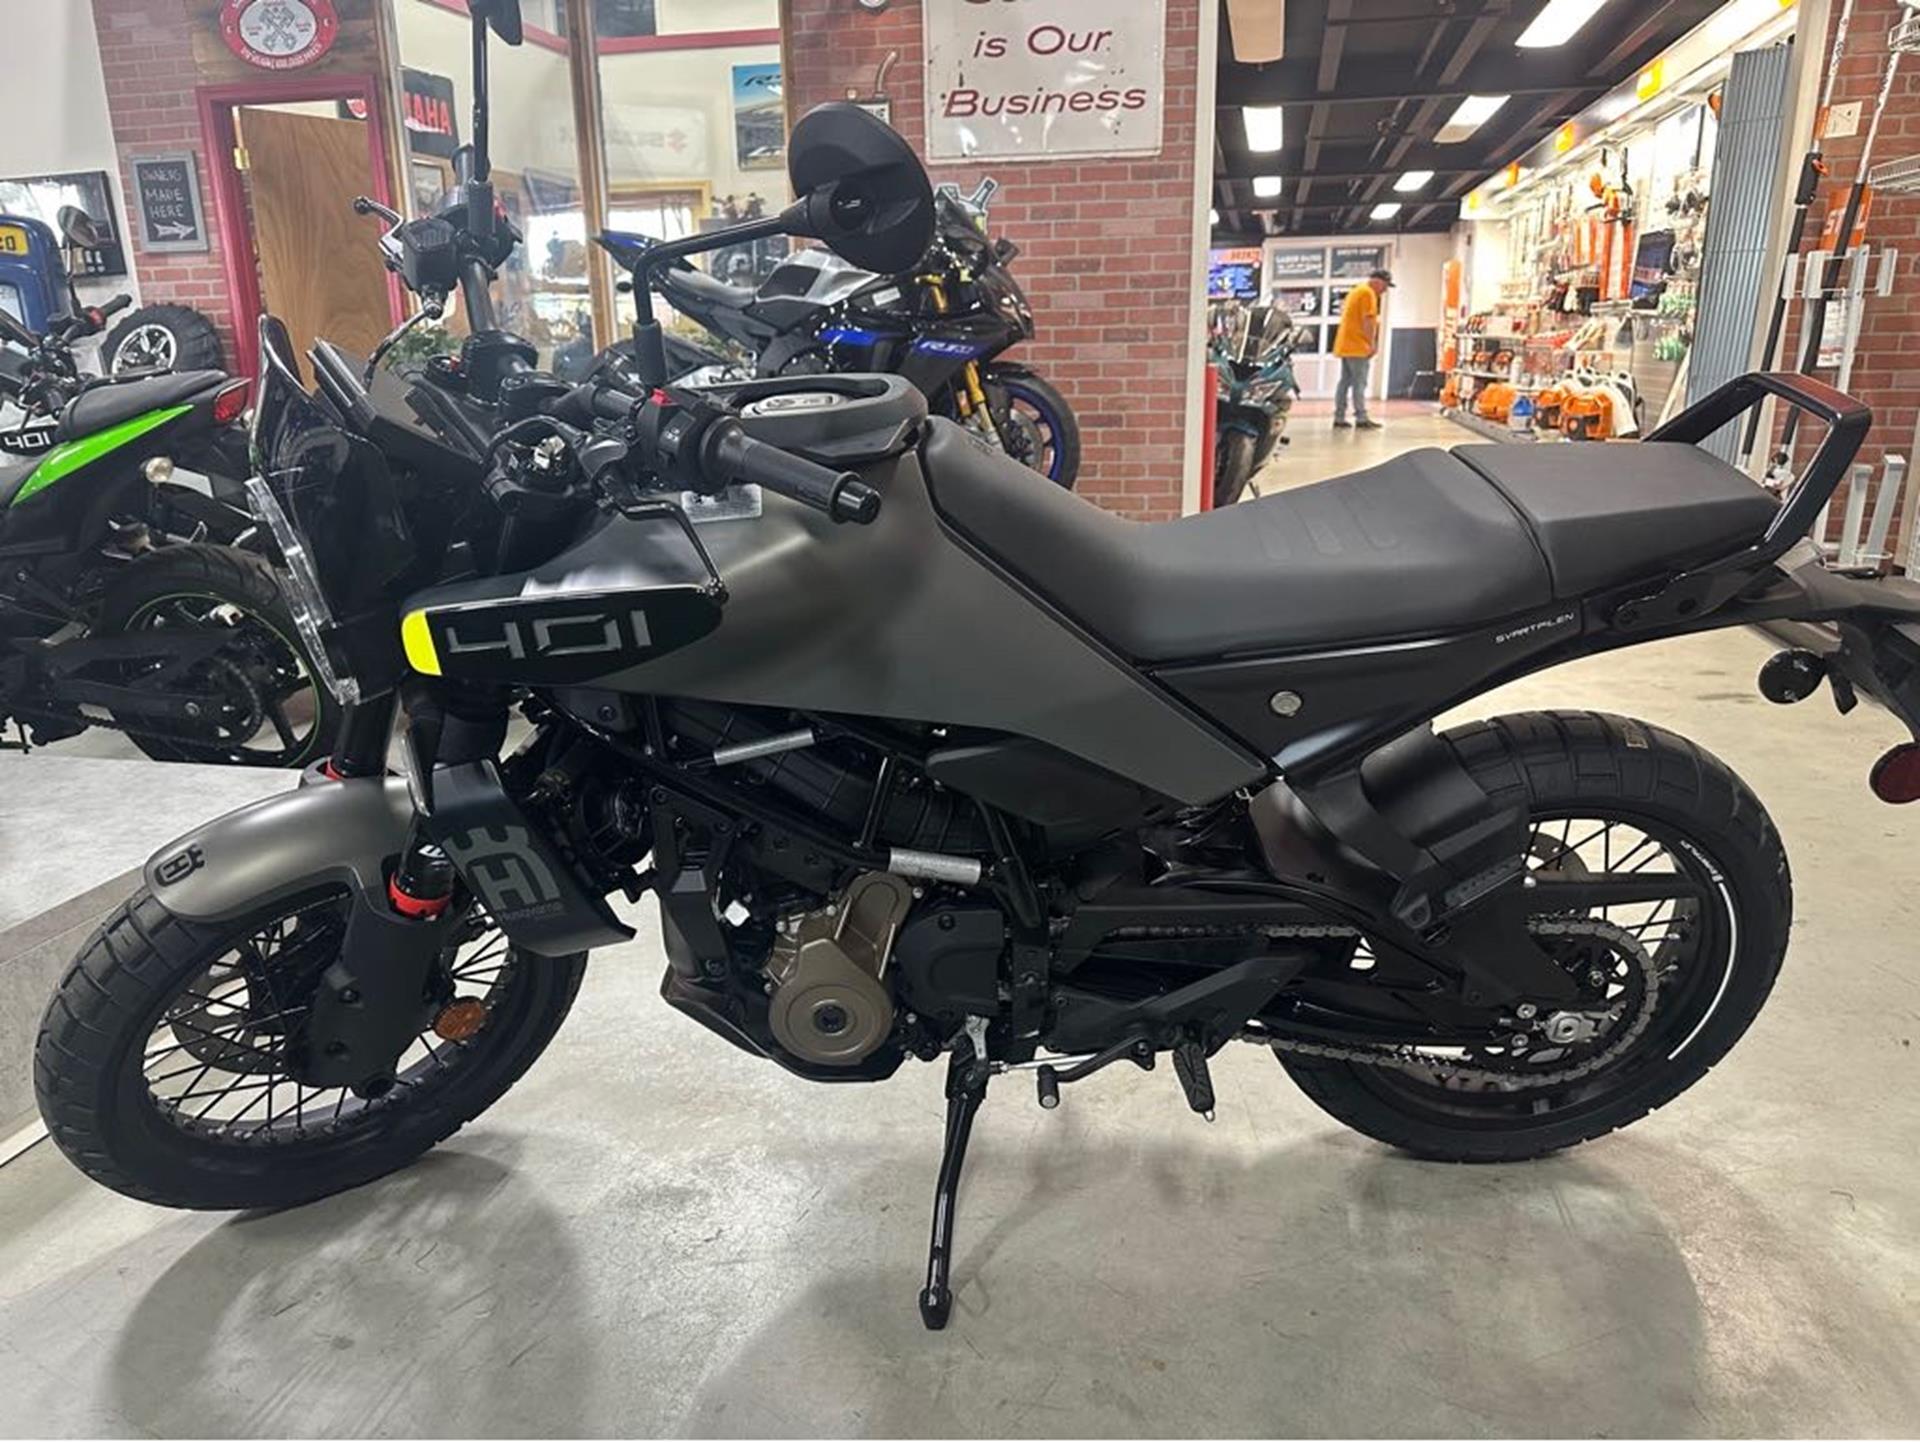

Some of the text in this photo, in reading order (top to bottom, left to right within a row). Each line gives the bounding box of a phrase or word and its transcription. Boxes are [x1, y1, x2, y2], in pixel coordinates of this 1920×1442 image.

[974, 25, 1113, 58] is Our
[943, 87, 1148, 118] Business
[144, 188, 184, 202] MADE
[150, 204, 184, 218] HERE
[4, 431, 51, 448] 401
[446, 610, 652, 659] 401
